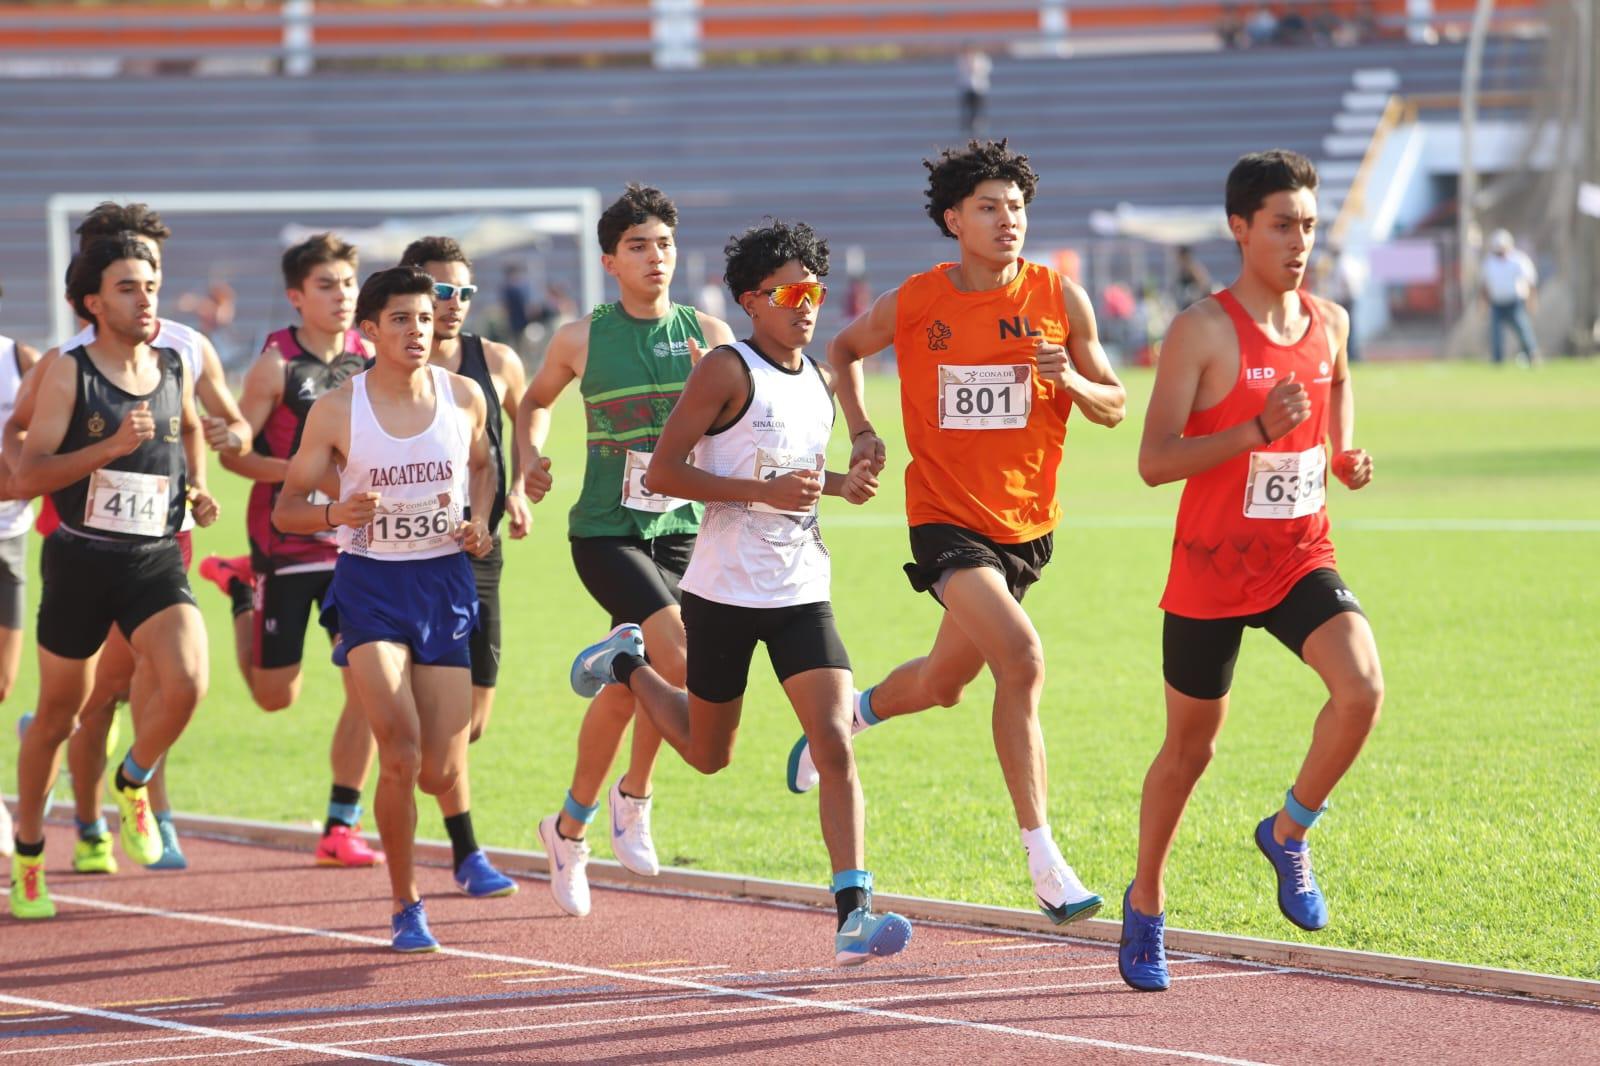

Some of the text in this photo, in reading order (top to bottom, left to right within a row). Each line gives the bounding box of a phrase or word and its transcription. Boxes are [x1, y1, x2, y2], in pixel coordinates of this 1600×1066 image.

[998, 316, 1041, 340] NL
[979, 370, 1014, 378] CONADE
[1246, 367, 1276, 380] IED
[956, 386, 1011, 415] 801
[752, 420, 786, 429] SINALOA
[370, 460, 453, 487] ZACATECAS
[1265, 470, 1315, 503] 635
[103, 492, 155, 520] 414
[376, 511, 449, 540] 1536
